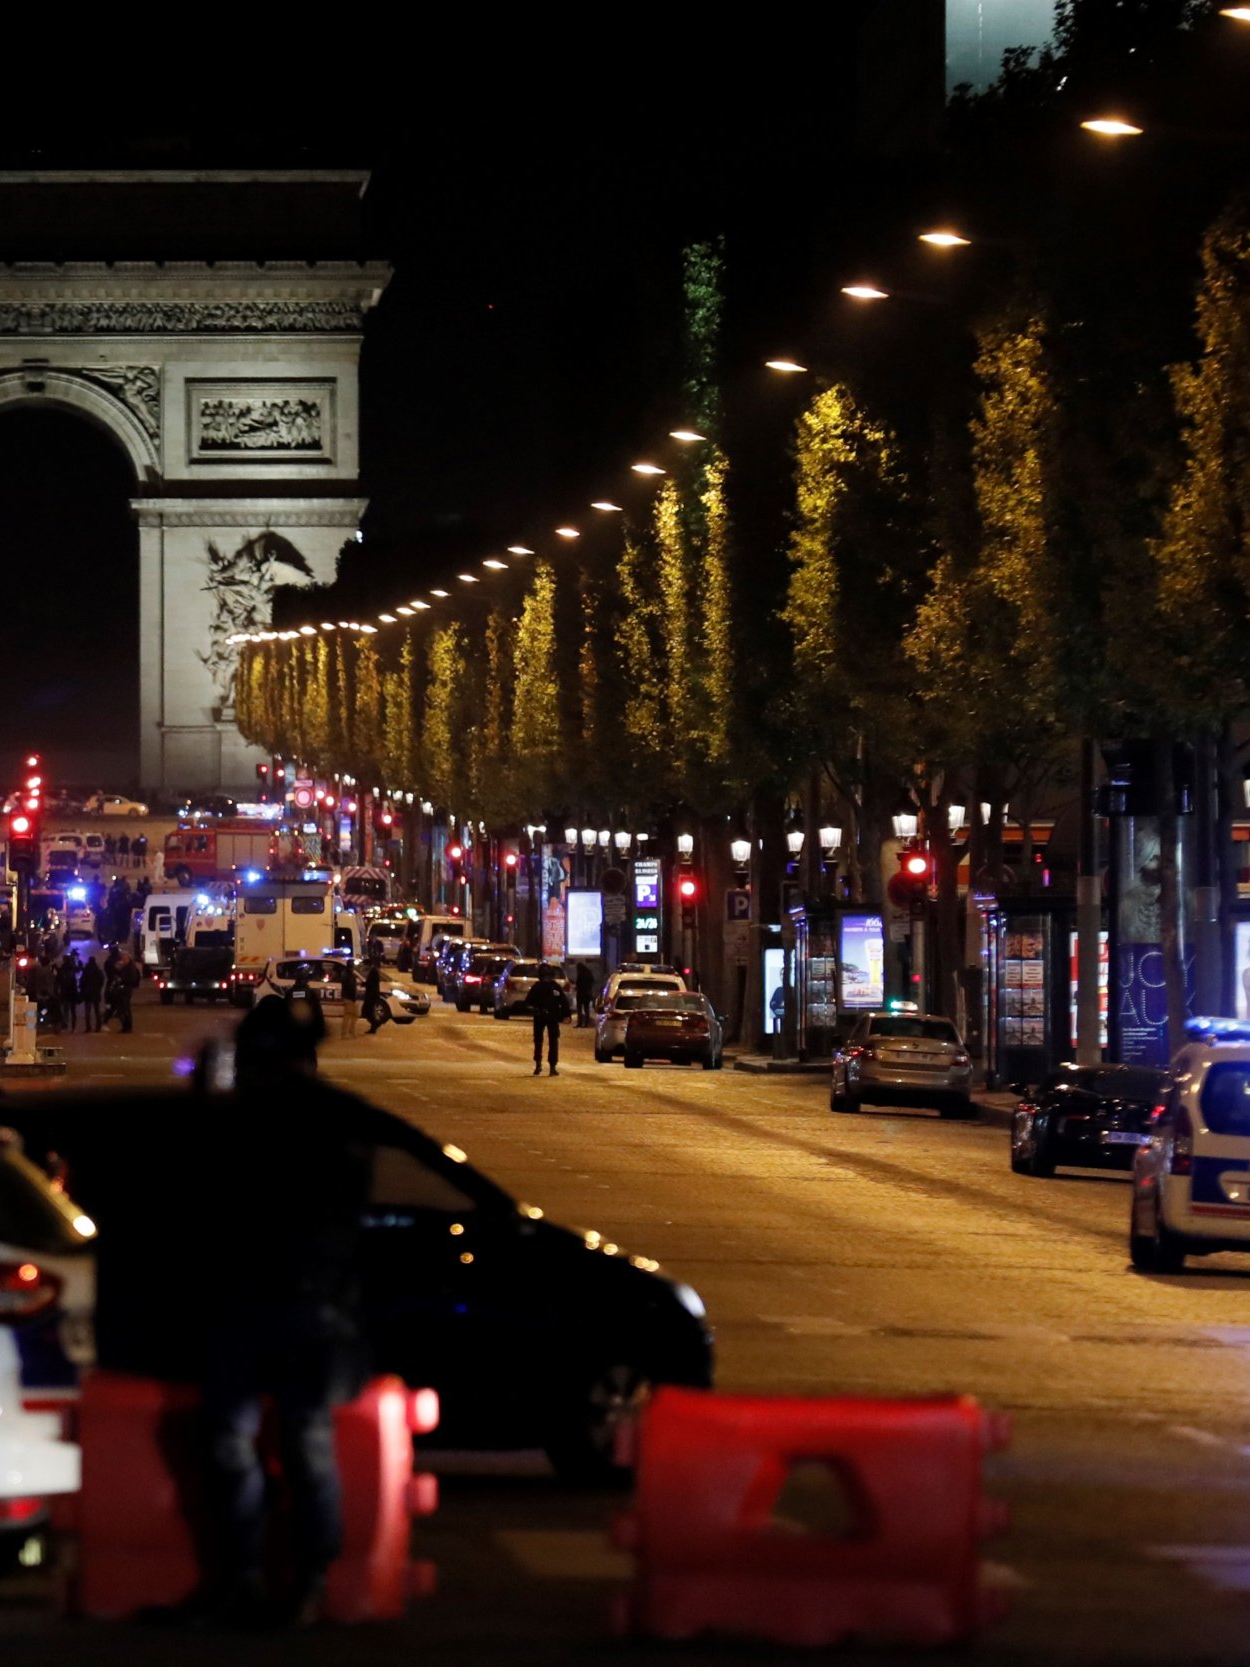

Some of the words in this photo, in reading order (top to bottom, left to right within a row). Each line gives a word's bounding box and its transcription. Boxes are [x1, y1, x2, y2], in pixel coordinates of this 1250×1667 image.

[637, 884, 651, 902] P
[734, 896, 749, 916] P
[320, 988, 342, 999] ICE
